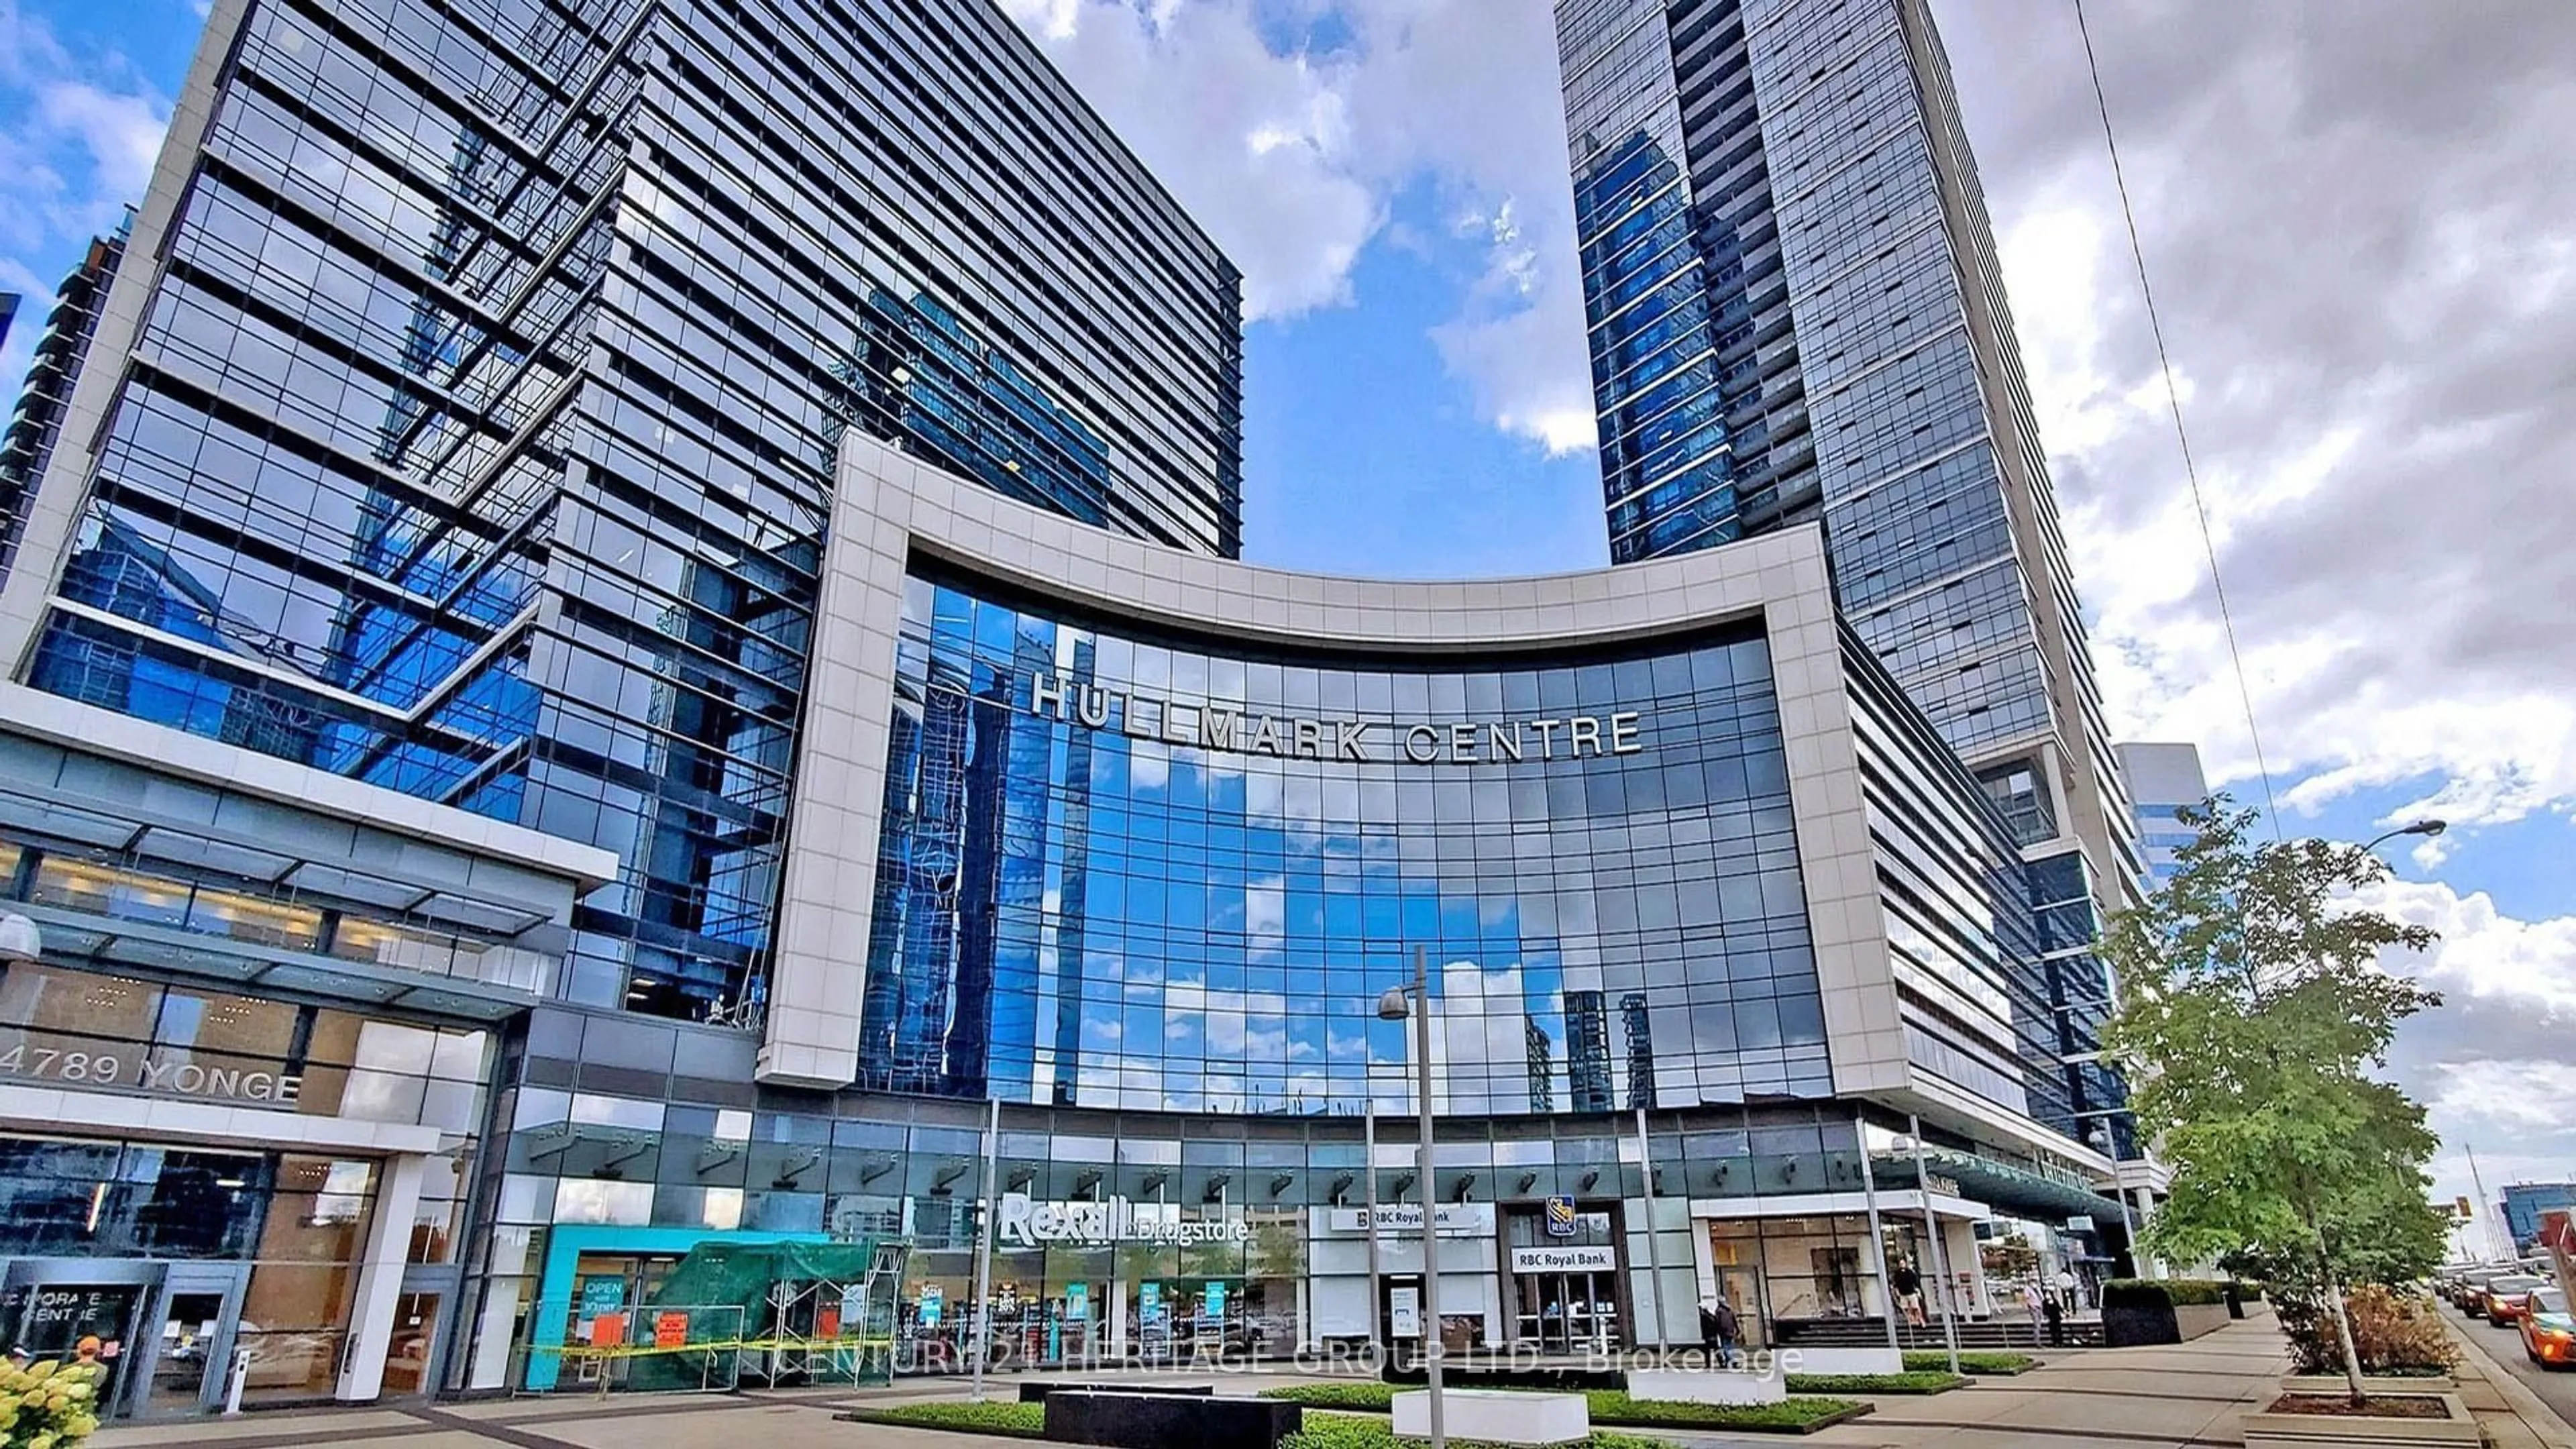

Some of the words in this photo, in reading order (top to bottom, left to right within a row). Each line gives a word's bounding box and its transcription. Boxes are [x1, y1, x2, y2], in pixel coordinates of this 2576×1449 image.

[1030, 672, 1373, 763] HULLMARK
[1403, 710, 1644, 765] CENTRE
[0, 1044, 119, 1083] 4789
[138, 1059, 303, 1104] YONGE
[998, 1192, 1132, 1246] Rexall
[1137, 1216, 1249, 1246] Drugstore
[1395, 1210, 1424, 1226] Royal
[1551, 1222, 1573, 1232] RBC
[1519, 1254, 1542, 1267] RBC
[1545, 1252, 1576, 1268] Royal
[1578, 1252, 1607, 1265] Bank
[585, 1282, 622, 1294] OPEN
